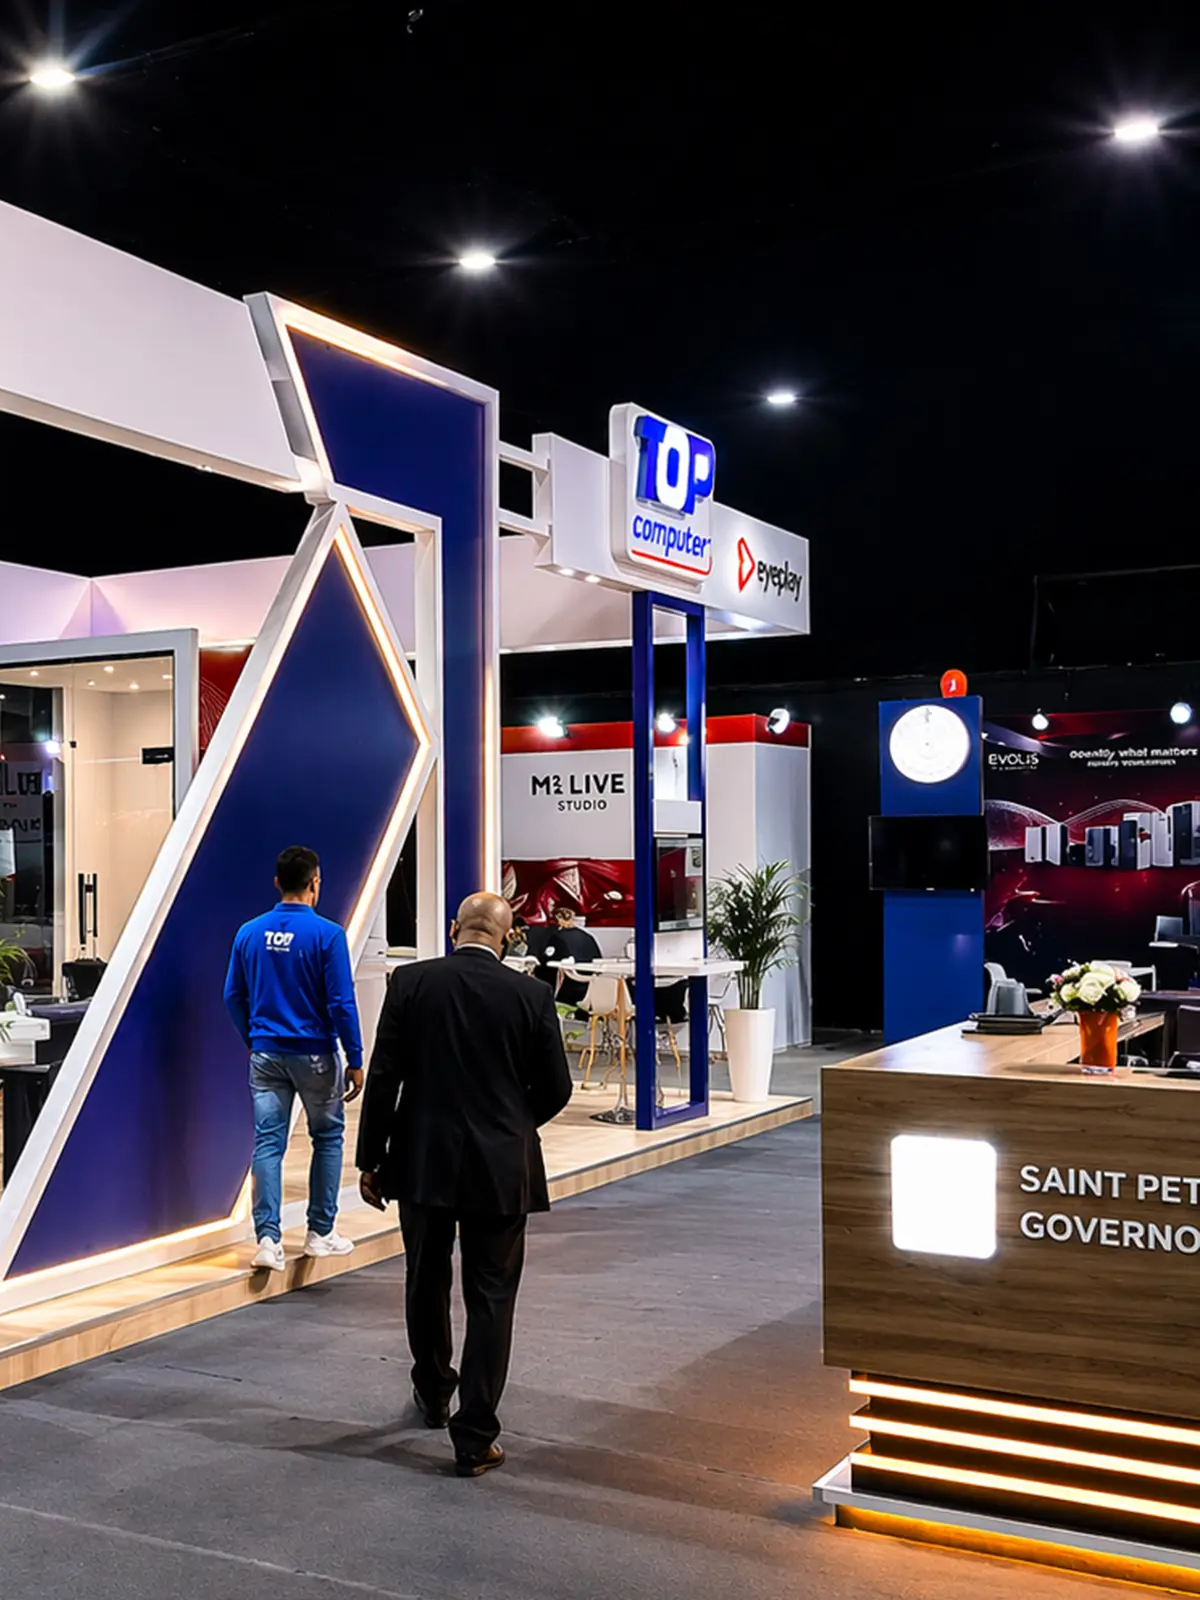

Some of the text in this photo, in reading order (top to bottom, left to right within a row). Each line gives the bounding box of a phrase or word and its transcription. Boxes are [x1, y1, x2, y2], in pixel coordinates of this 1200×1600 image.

[634, 415, 715, 515] TOP
[632, 514, 711, 558] computer
[757, 560, 803, 602] eyeplay
[569, 773, 625, 795] LIVE
[557, 799, 608, 812] STUDIO
[1020, 1165, 1200, 1205] SAINT PET
[1020, 1211, 1200, 1254] GOVERNO
